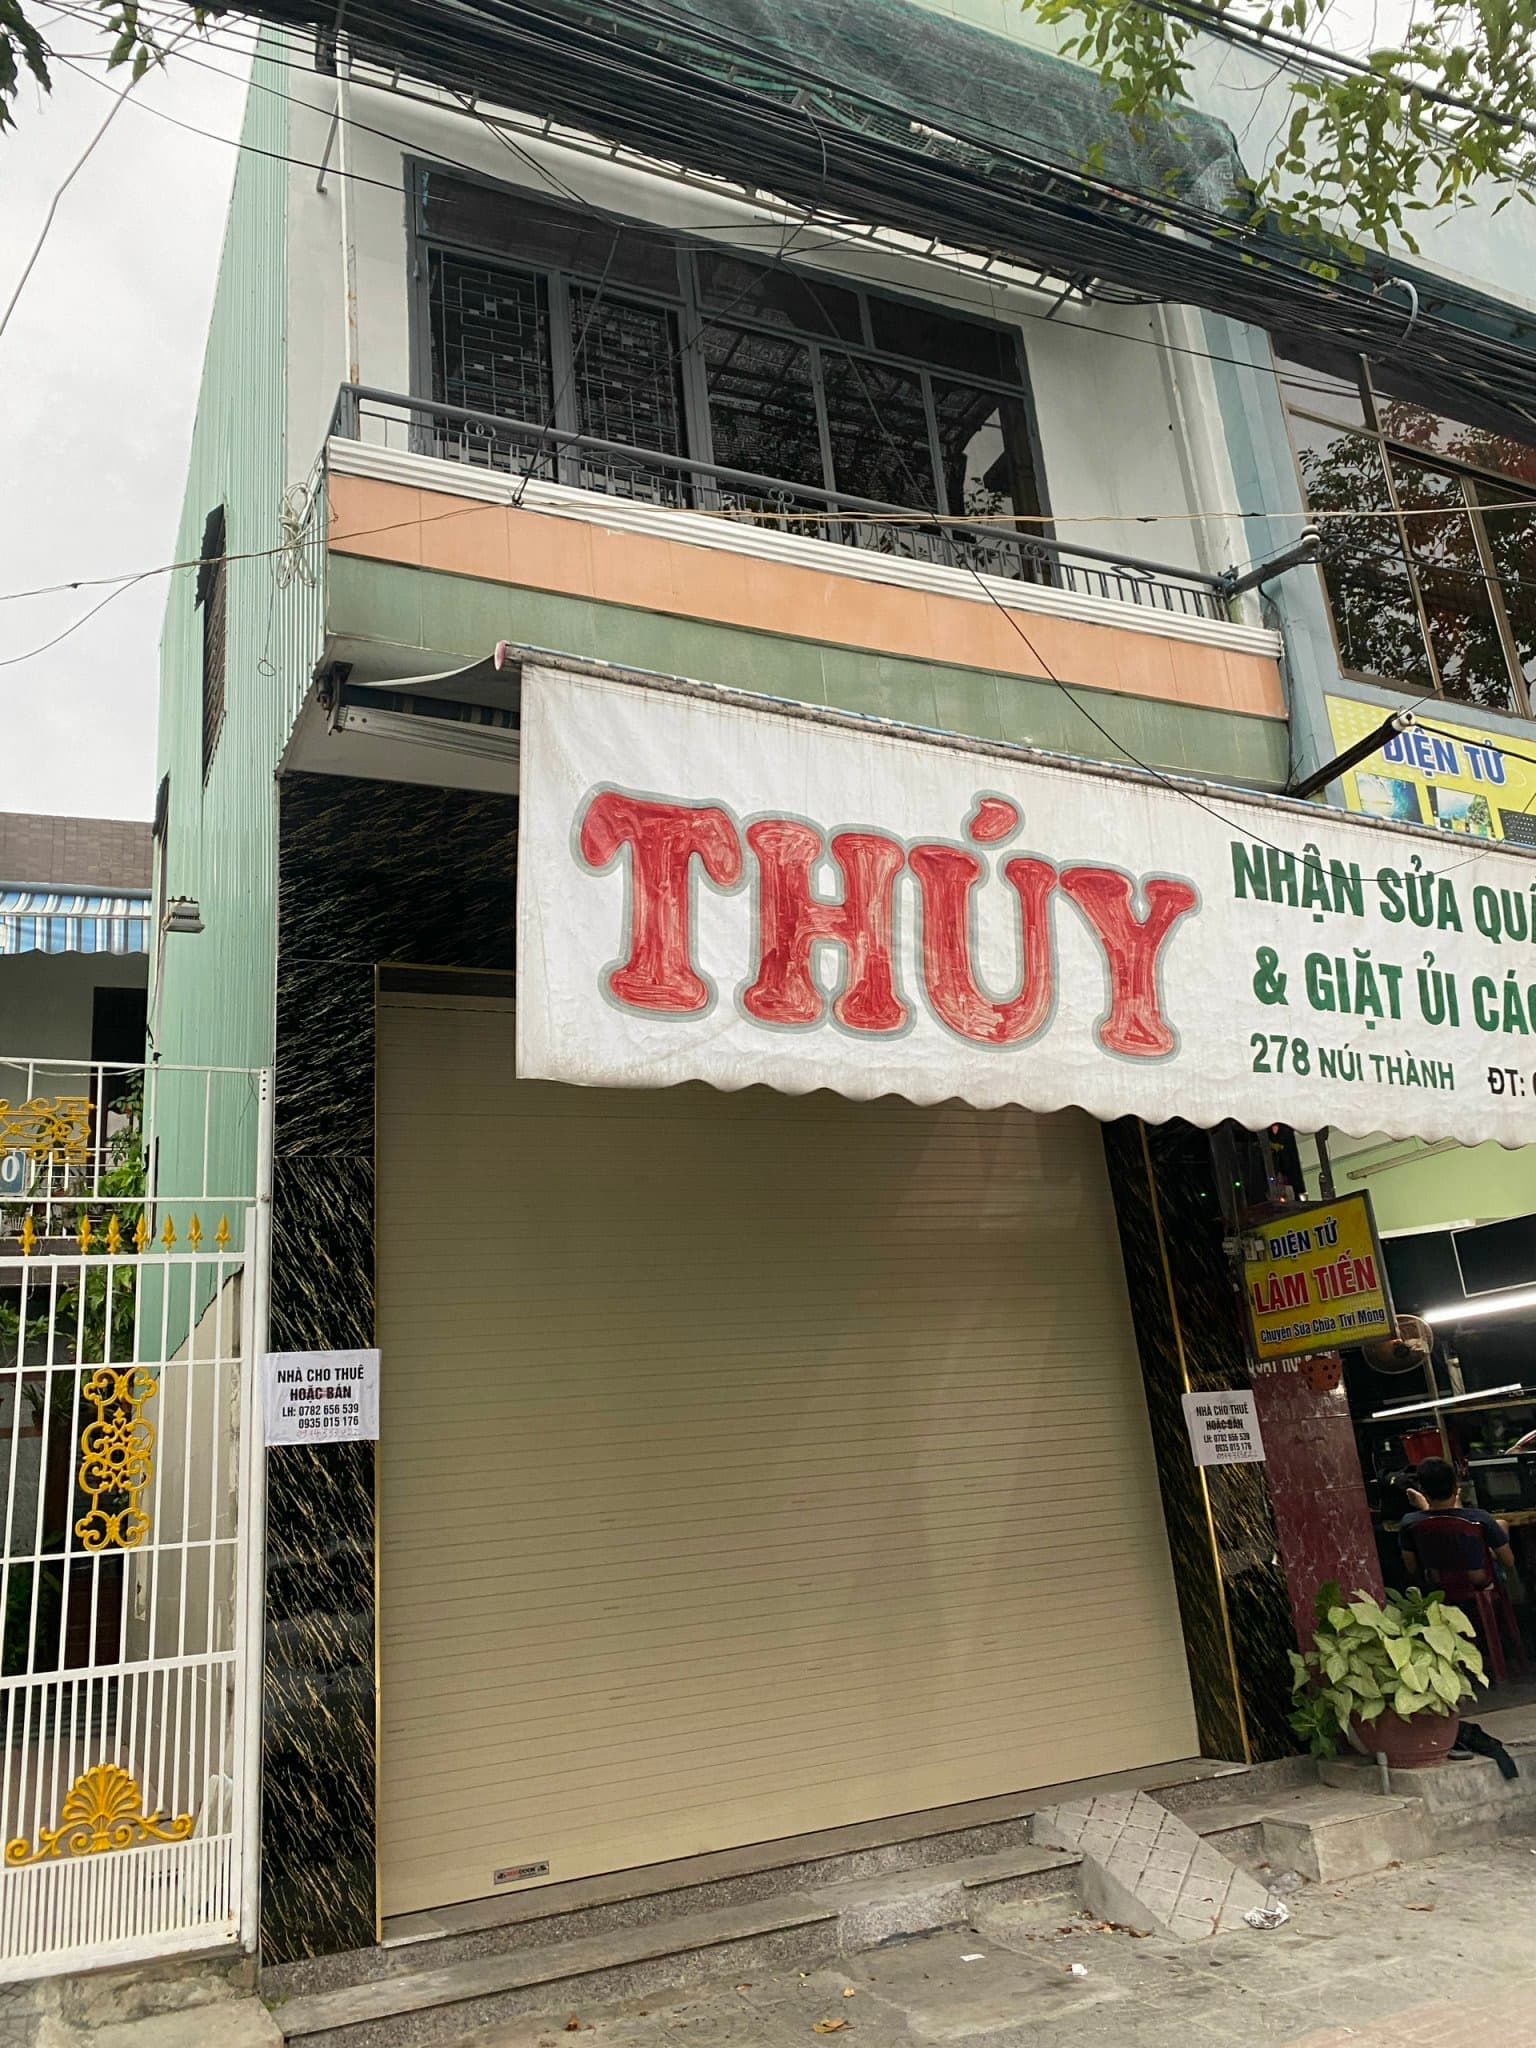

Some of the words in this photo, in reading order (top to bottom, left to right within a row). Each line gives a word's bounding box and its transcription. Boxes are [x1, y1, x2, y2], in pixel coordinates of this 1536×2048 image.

[1463, 739, 1506, 785] TỬ
[1230, 842, 1365, 923] NHẬN
[1376, 854, 1464, 932] SỬA
[1473, 876, 1536, 944] QU
[1253, 946, 1289, 1006] &
[1304, 947, 1403, 1031] GIẶT
[1416, 950, 1461, 1027] ỦI
[1250, 1032, 1311, 1077] 278
[1318, 1043, 1364, 1082] NÚI
[1369, 1049, 1455, 1091] THÀNH
[1488, 1066, 1526, 1097] ĐT:
[1269, 1229, 1312, 1259] ĐIỆN
[1314, 1216, 1338, 1249] TỬ
[1253, 1272, 1310, 1315] LÂM
[1313, 1249, 1378, 1301] TIẾN
[1338, 1312, 1356, 1328] Tivi
[277, 1366, 303, 1383] NHÀ
[306, 1368, 331, 1382] CHO
[334, 1364, 364, 1380] THUÊ
[290, 1385, 322, 1403] HOẶC
[326, 1383, 352, 1400] BÁN
[282, 1406, 296, 1417] LH:
[298, 1405, 321, 1416] 0782
[323, 1404, 340, 1415] 656
[342, 1403, 359, 1414] 539
[298, 1418, 321, 1429] 0935
[323, 1417, 340, 1428] 015
[1196, 1403, 1212, 1417] NHÀ
[1213, 1405, 1229, 1416] CHO
